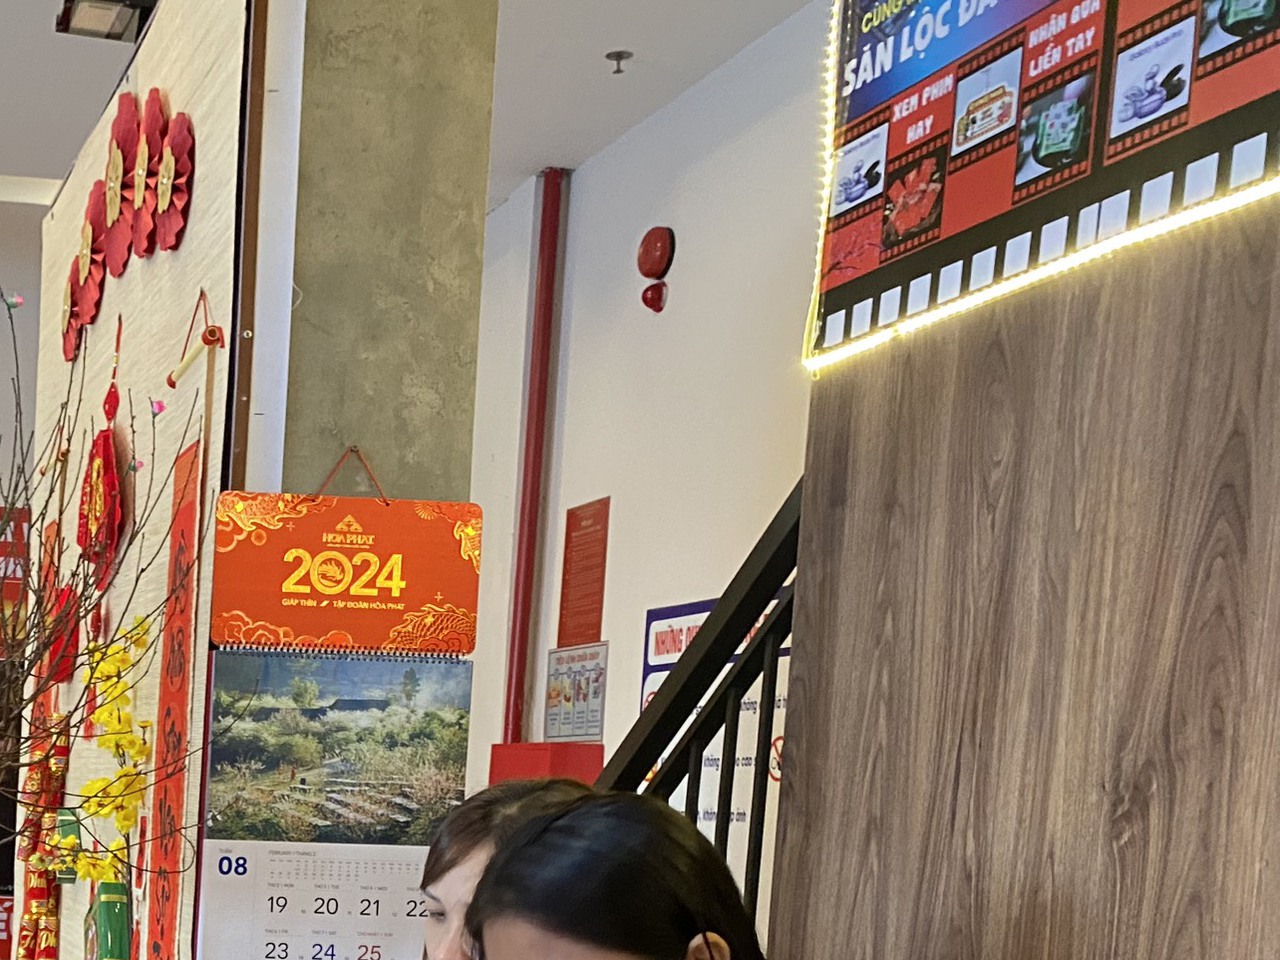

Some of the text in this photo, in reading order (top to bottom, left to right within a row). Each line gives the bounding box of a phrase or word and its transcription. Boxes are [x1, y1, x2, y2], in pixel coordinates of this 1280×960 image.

[1065, 26, 1096, 57] TAY
[891, 93, 920, 123] XEM
[921, 74, 955, 106] PHIM
[906, 114, 934, 144] HAY
[282, 548, 407, 598] 2024
[218, 855, 248, 876] 08
[267, 896, 429, 917] 19 20 21 22
[264, 942, 289, 960] 23
[311, 943, 337, 960] 24
